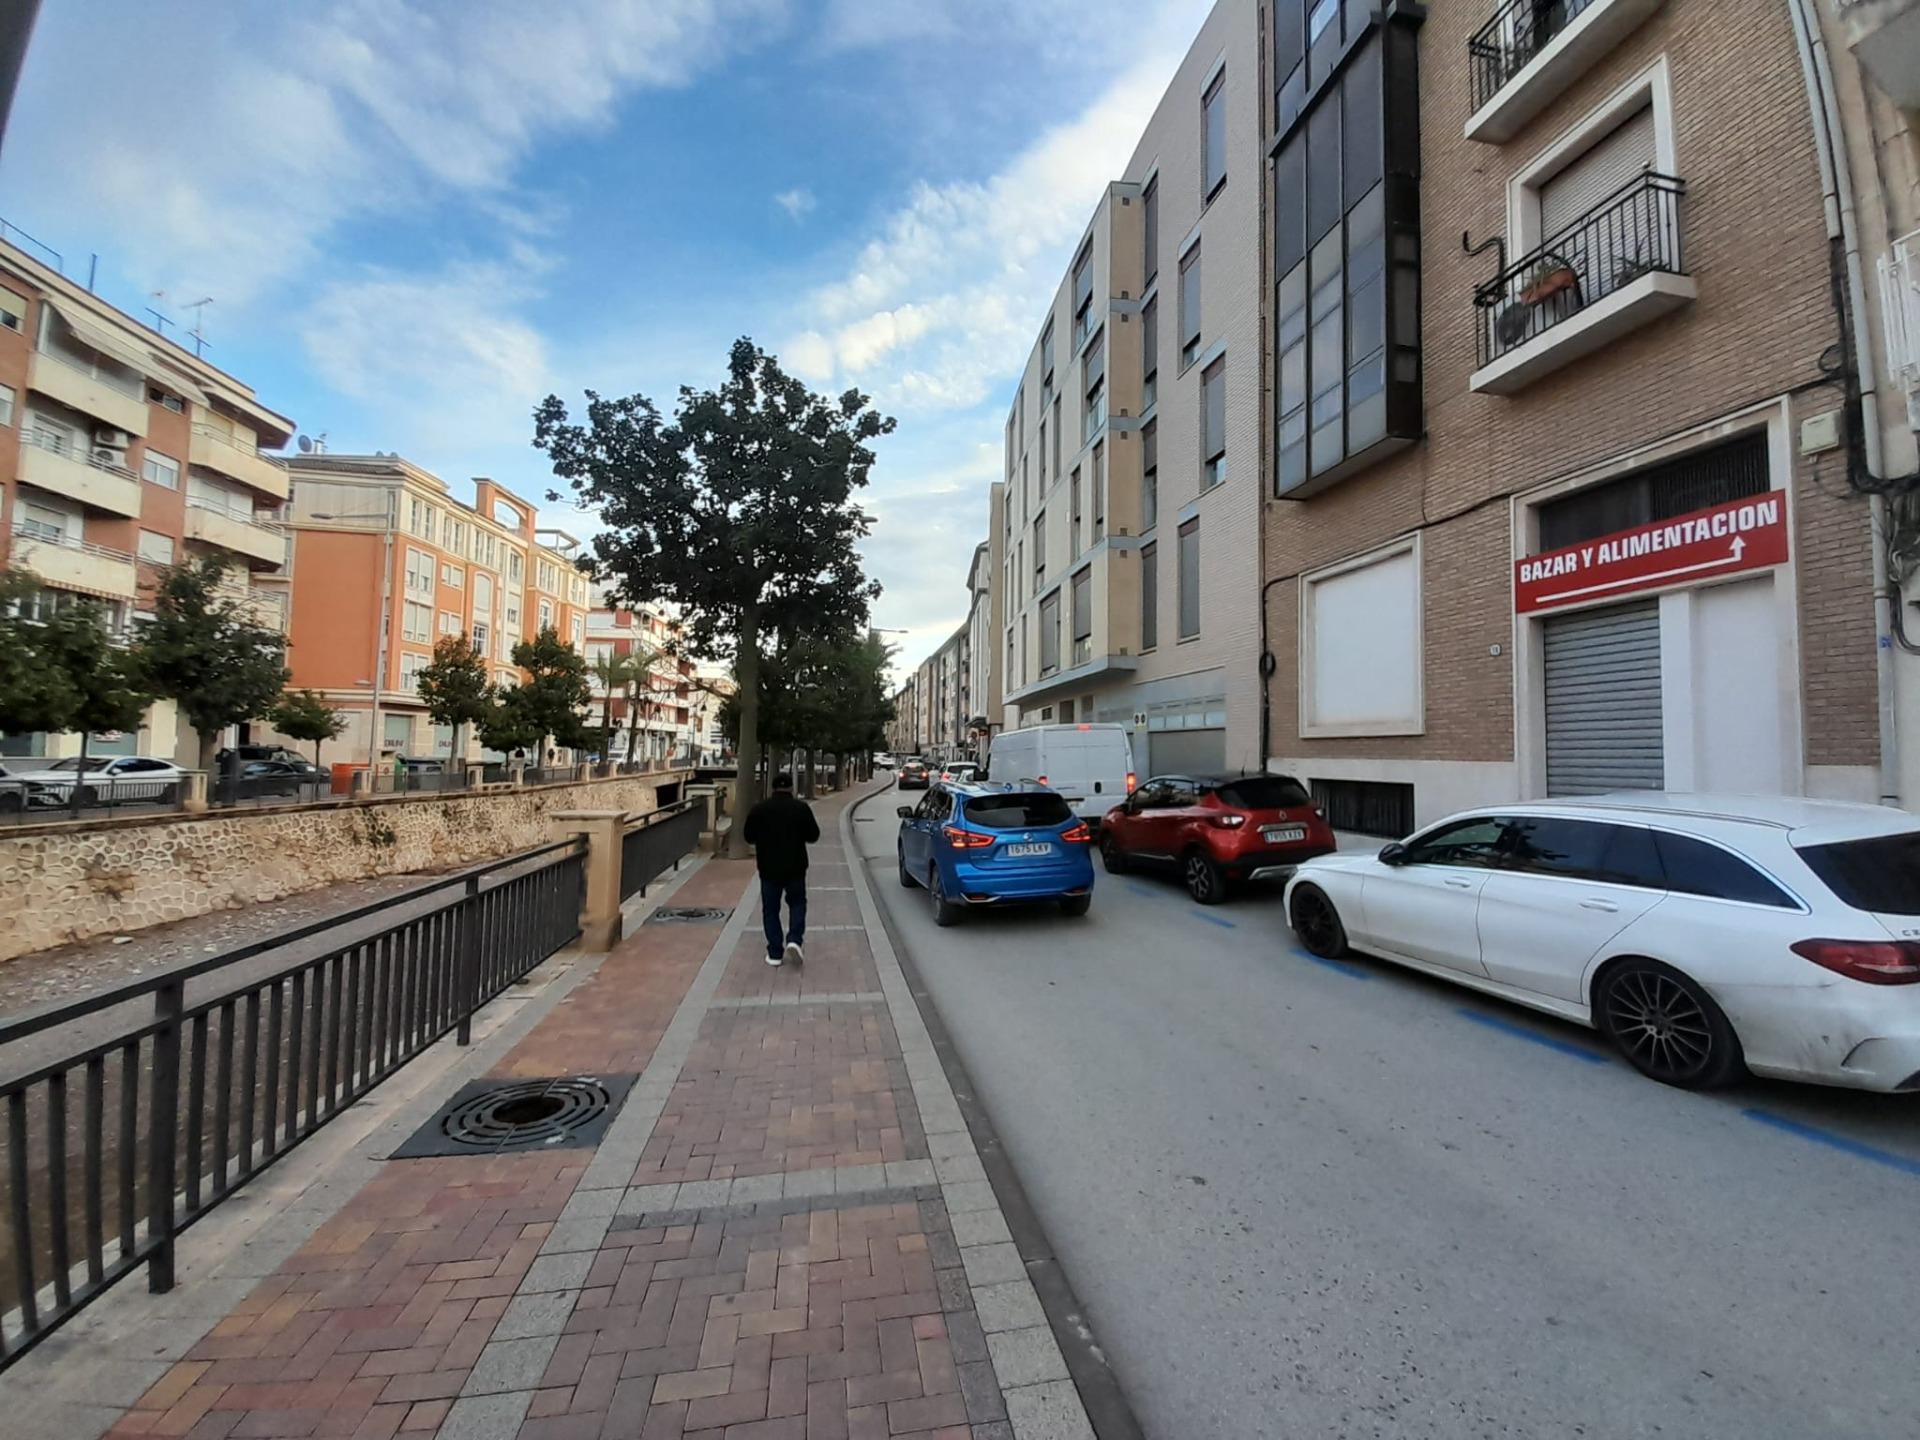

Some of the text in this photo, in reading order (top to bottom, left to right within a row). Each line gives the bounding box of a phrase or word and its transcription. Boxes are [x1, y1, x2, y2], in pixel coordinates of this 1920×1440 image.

[1520, 500, 1777, 583] BAZAR Y ALIMENTACION
